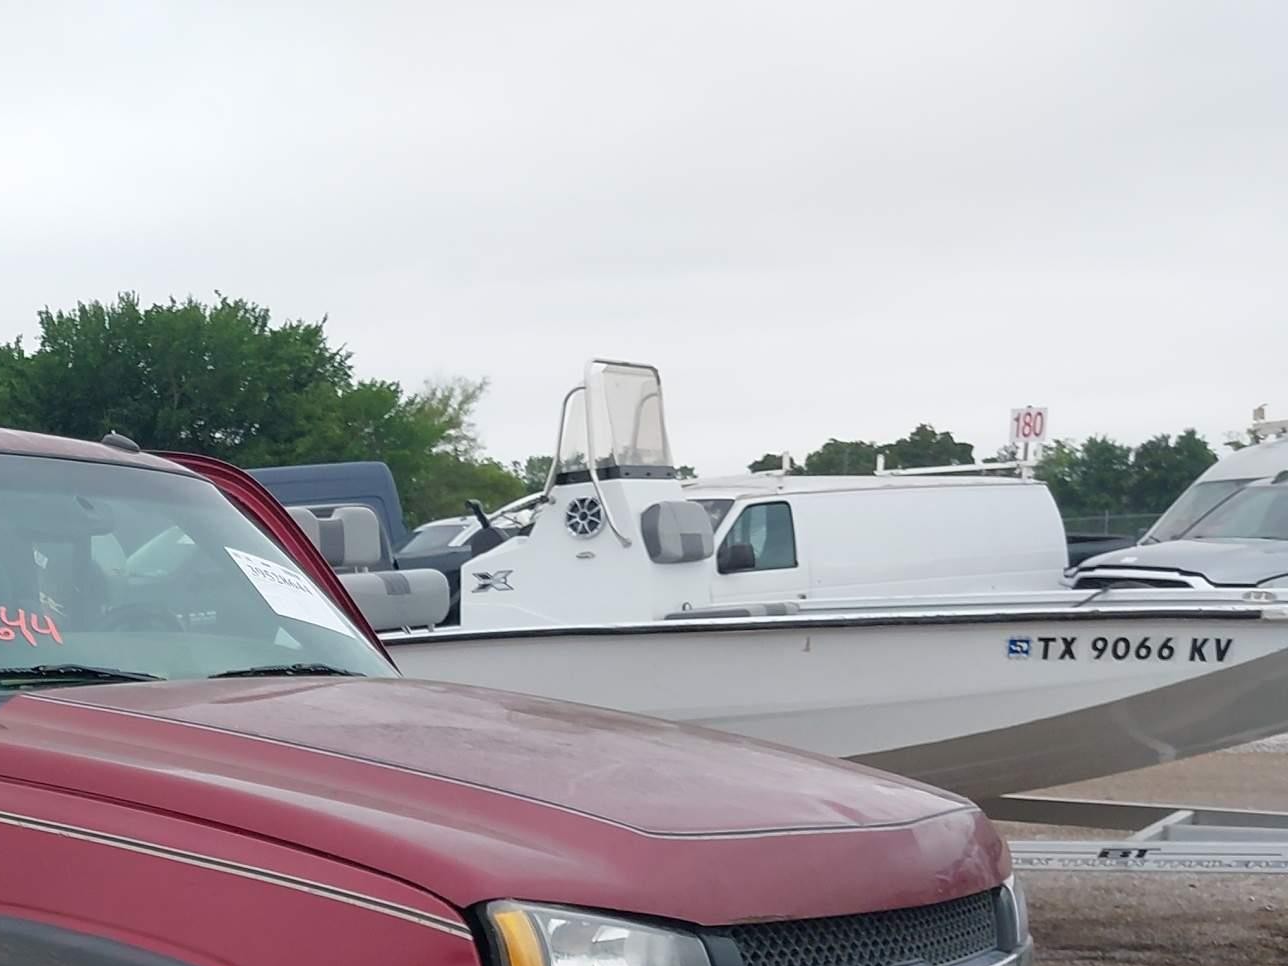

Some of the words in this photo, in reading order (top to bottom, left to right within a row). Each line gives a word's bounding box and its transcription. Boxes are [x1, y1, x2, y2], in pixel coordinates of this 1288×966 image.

[1013, 411, 1044, 438] 180
[1038, 637, 1076, 660] TX
[1091, 637, 1174, 661] 9066
[1189, 638, 1233, 662] KV
